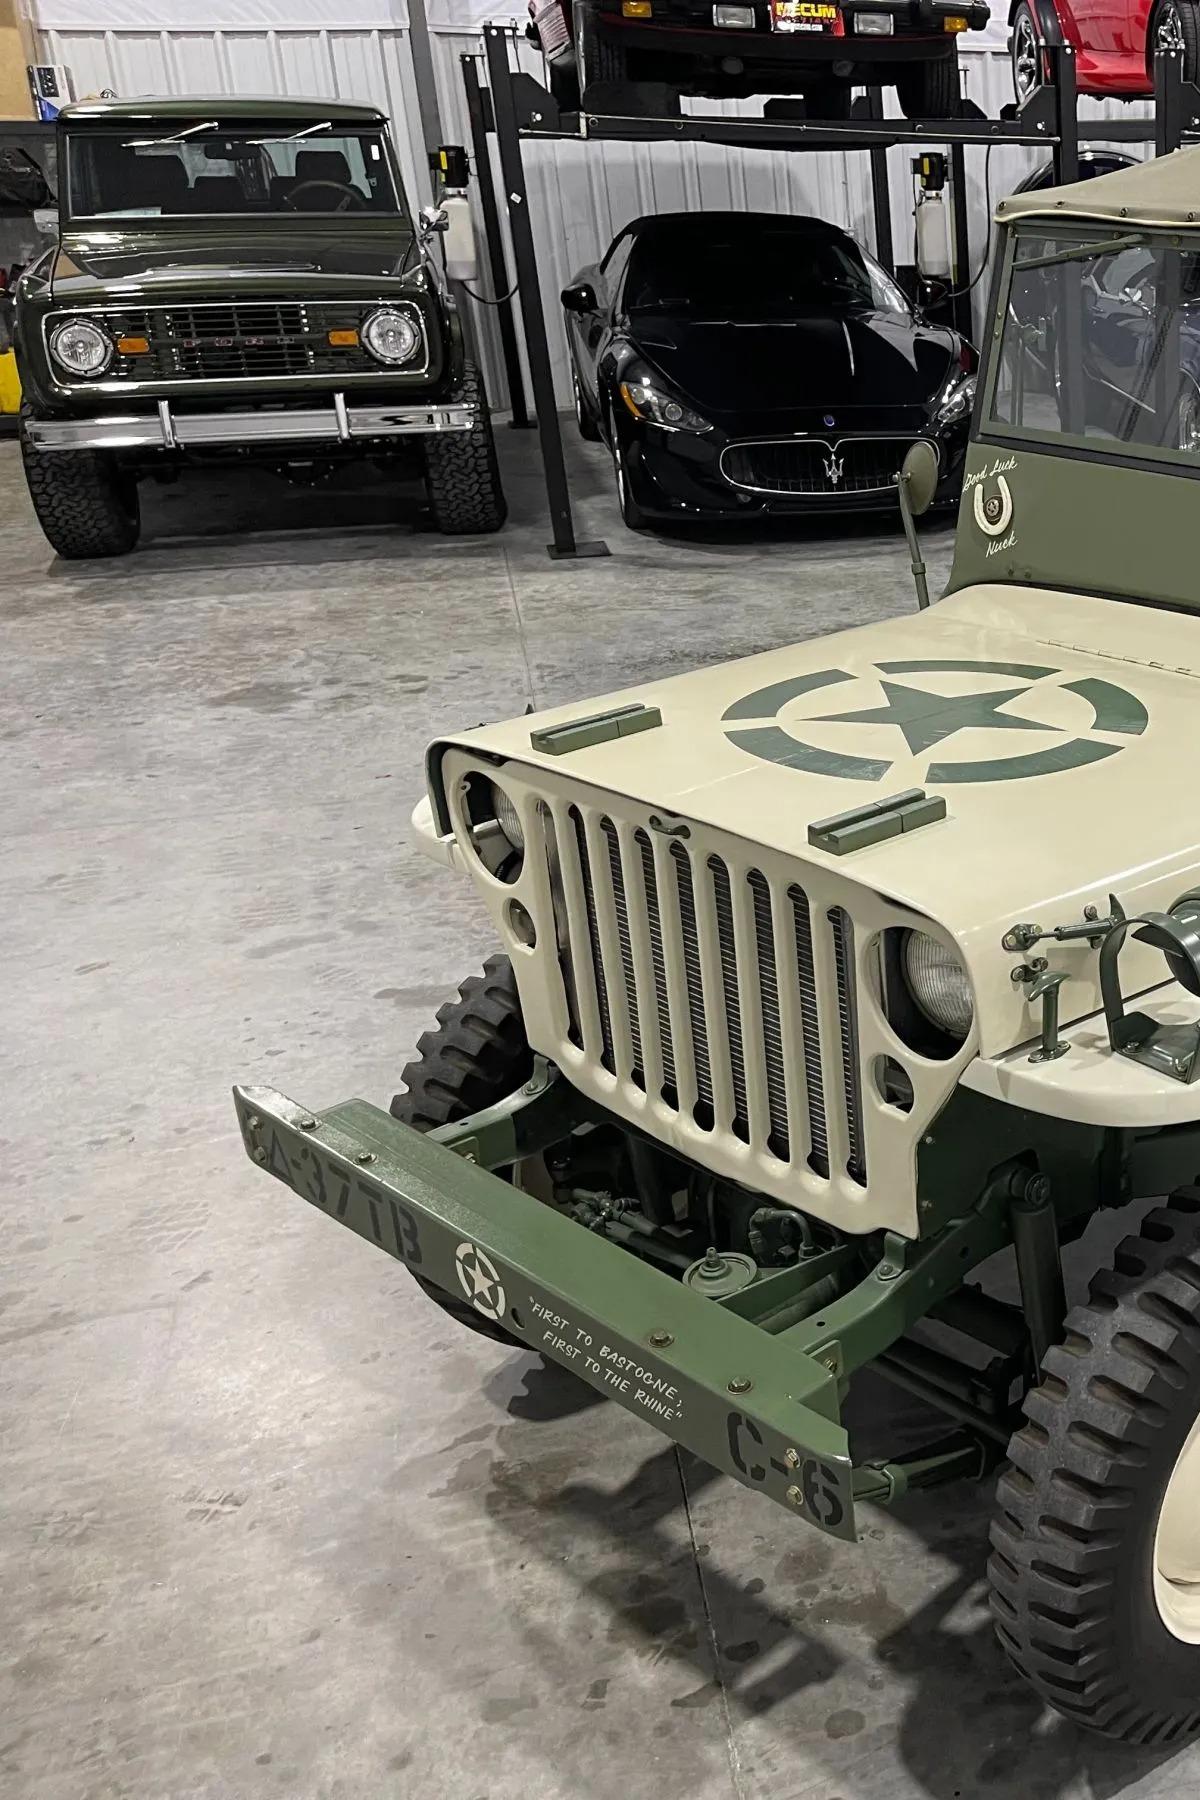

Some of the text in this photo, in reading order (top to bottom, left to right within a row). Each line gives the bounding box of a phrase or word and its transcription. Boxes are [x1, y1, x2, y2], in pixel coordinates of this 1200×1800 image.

[776, 3, 836, 18] MECUM
[962, 455, 1018, 493] Good Luck
[576, 1328, 593, 1346] TO
[543, 1330, 581, 1359] FIRST
[585, 1357, 600, 1373] TO
[604, 1368, 630, 1393] THE
[727, 1412, 843, 1526] C-6
